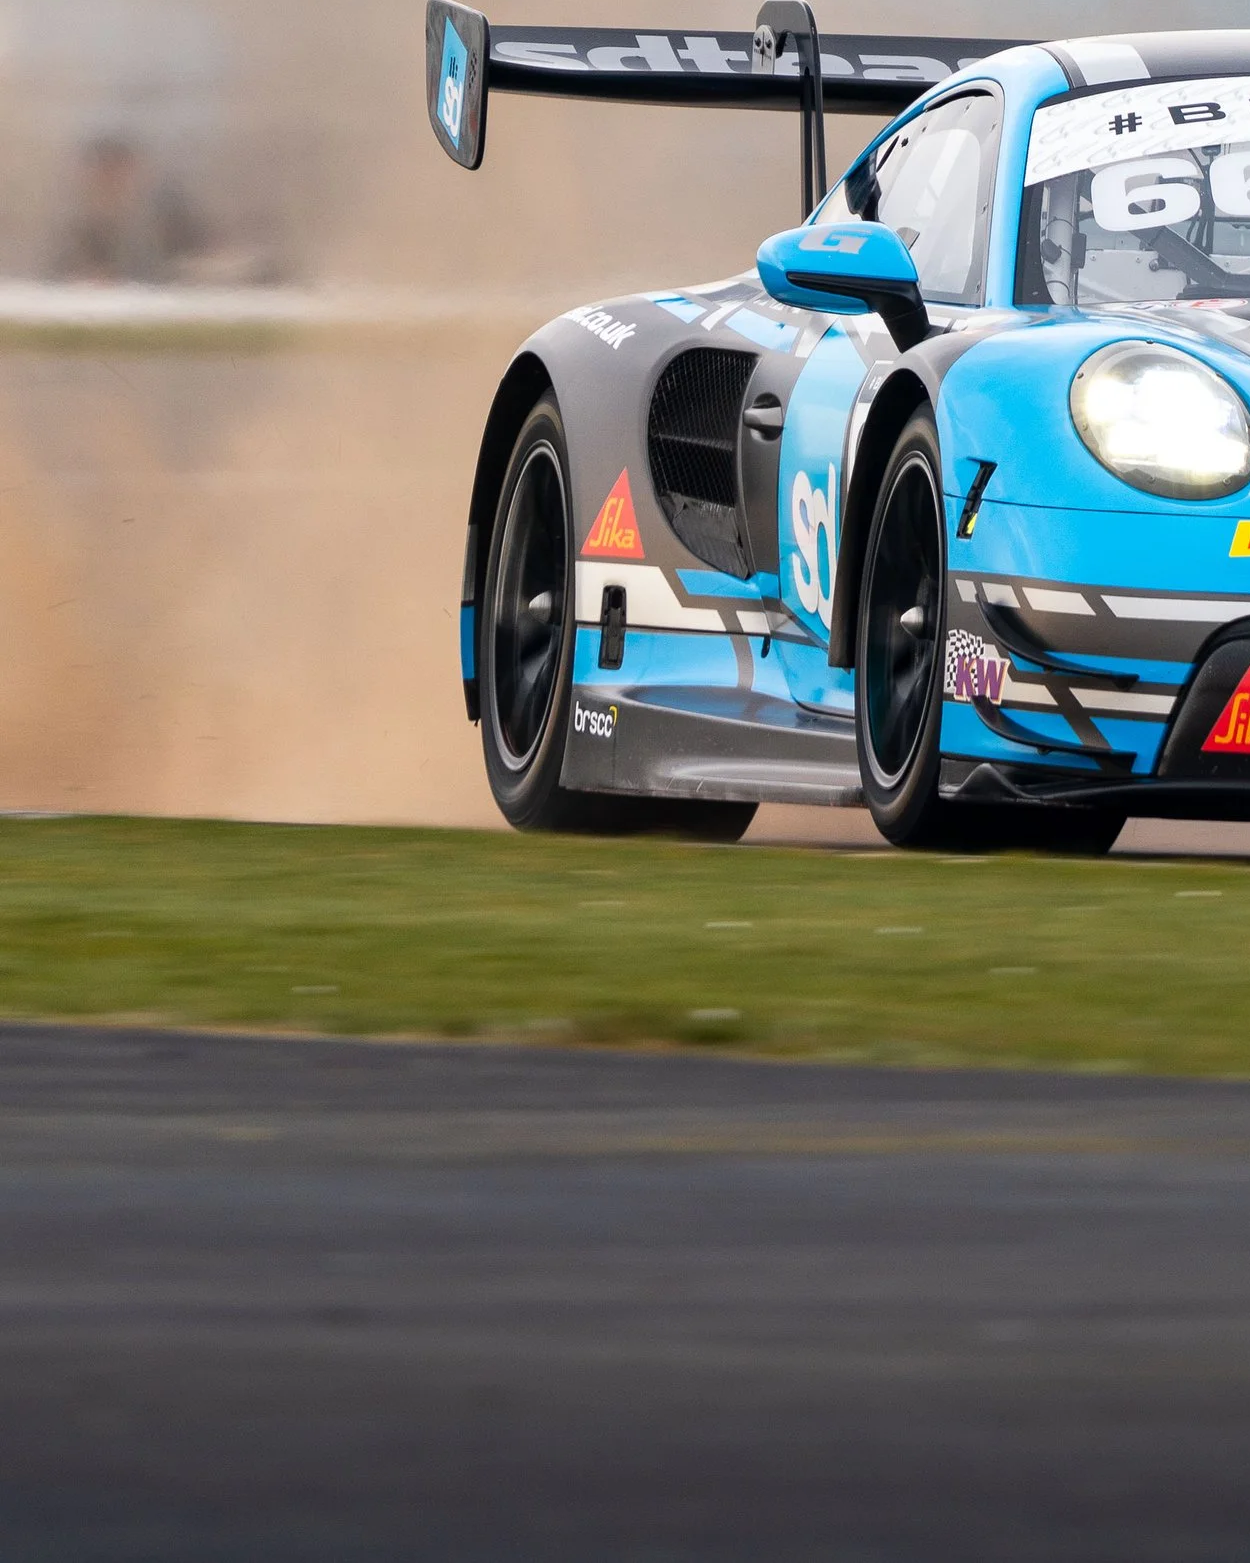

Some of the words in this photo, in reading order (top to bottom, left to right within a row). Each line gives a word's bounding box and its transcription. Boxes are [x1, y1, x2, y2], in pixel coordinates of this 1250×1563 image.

[494, 34, 996, 82] sdtea
[588, 497, 635, 549] Sika
[574, 700, 614, 738] brscc
